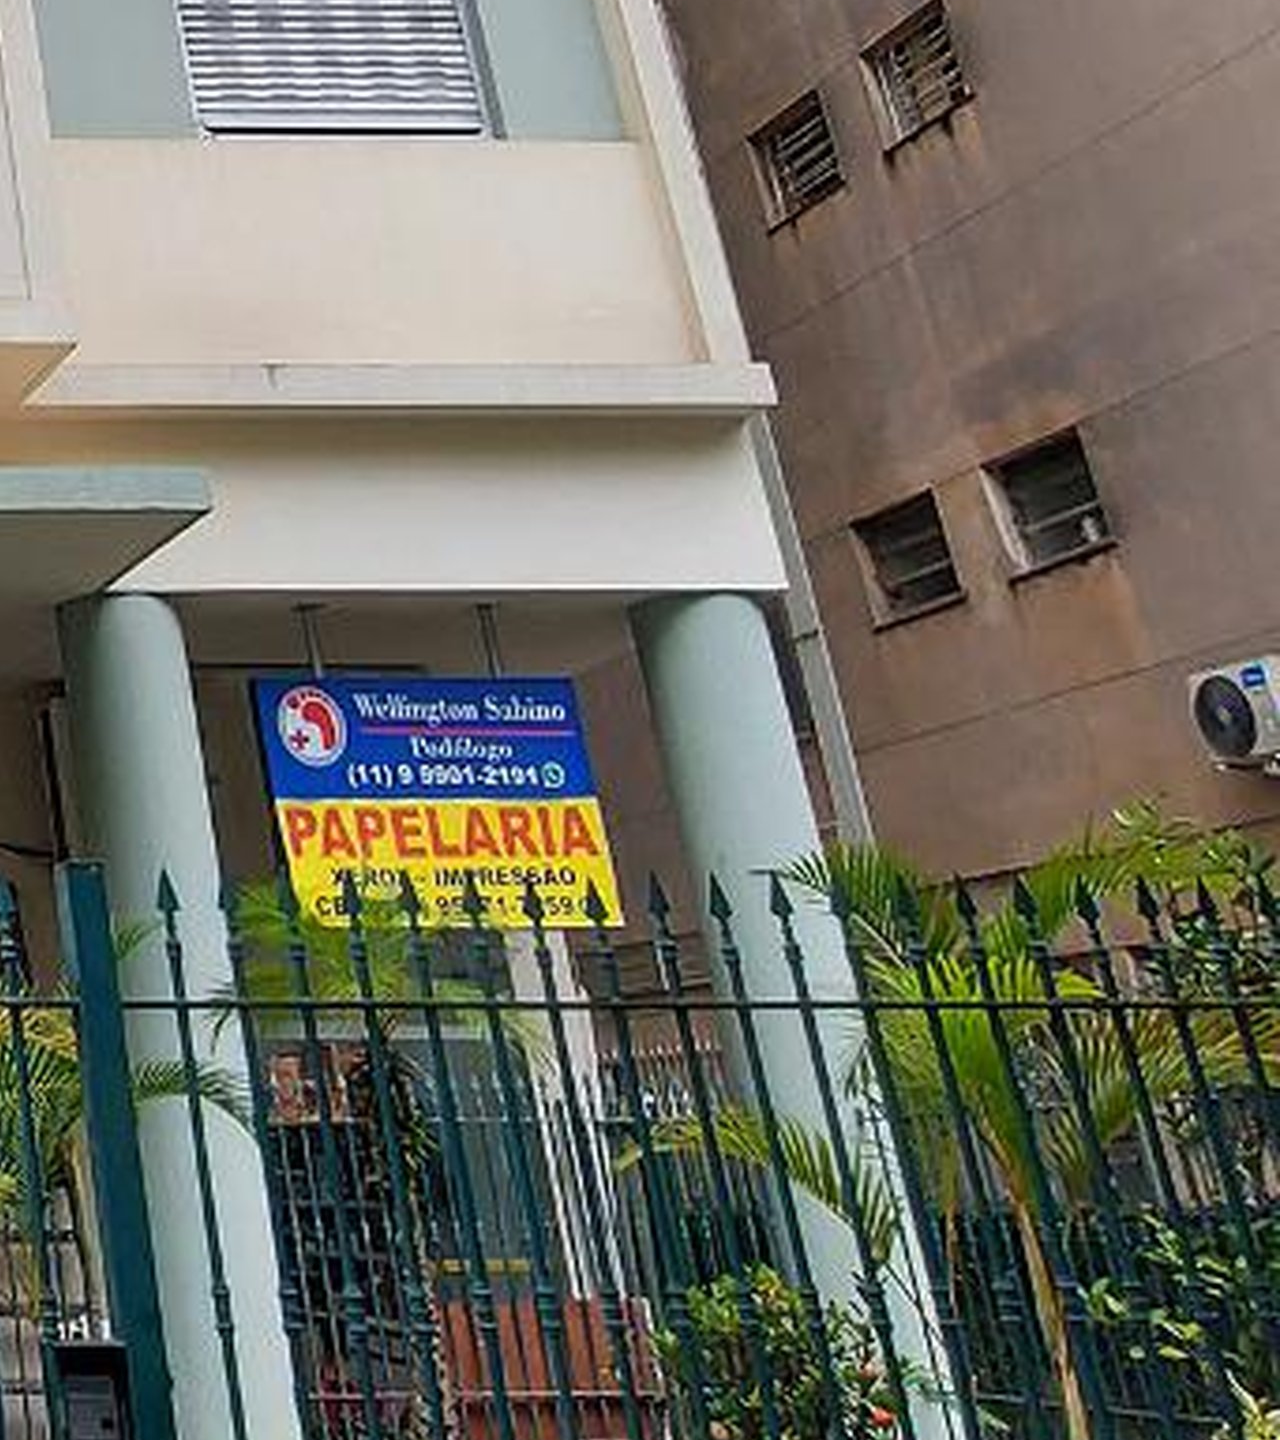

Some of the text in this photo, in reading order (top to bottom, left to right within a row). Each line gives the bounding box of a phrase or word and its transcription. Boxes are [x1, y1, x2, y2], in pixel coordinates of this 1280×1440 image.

[352, 693, 566, 728] Wellington Sabino
[285, 805, 600, 860] PAPELARIA
